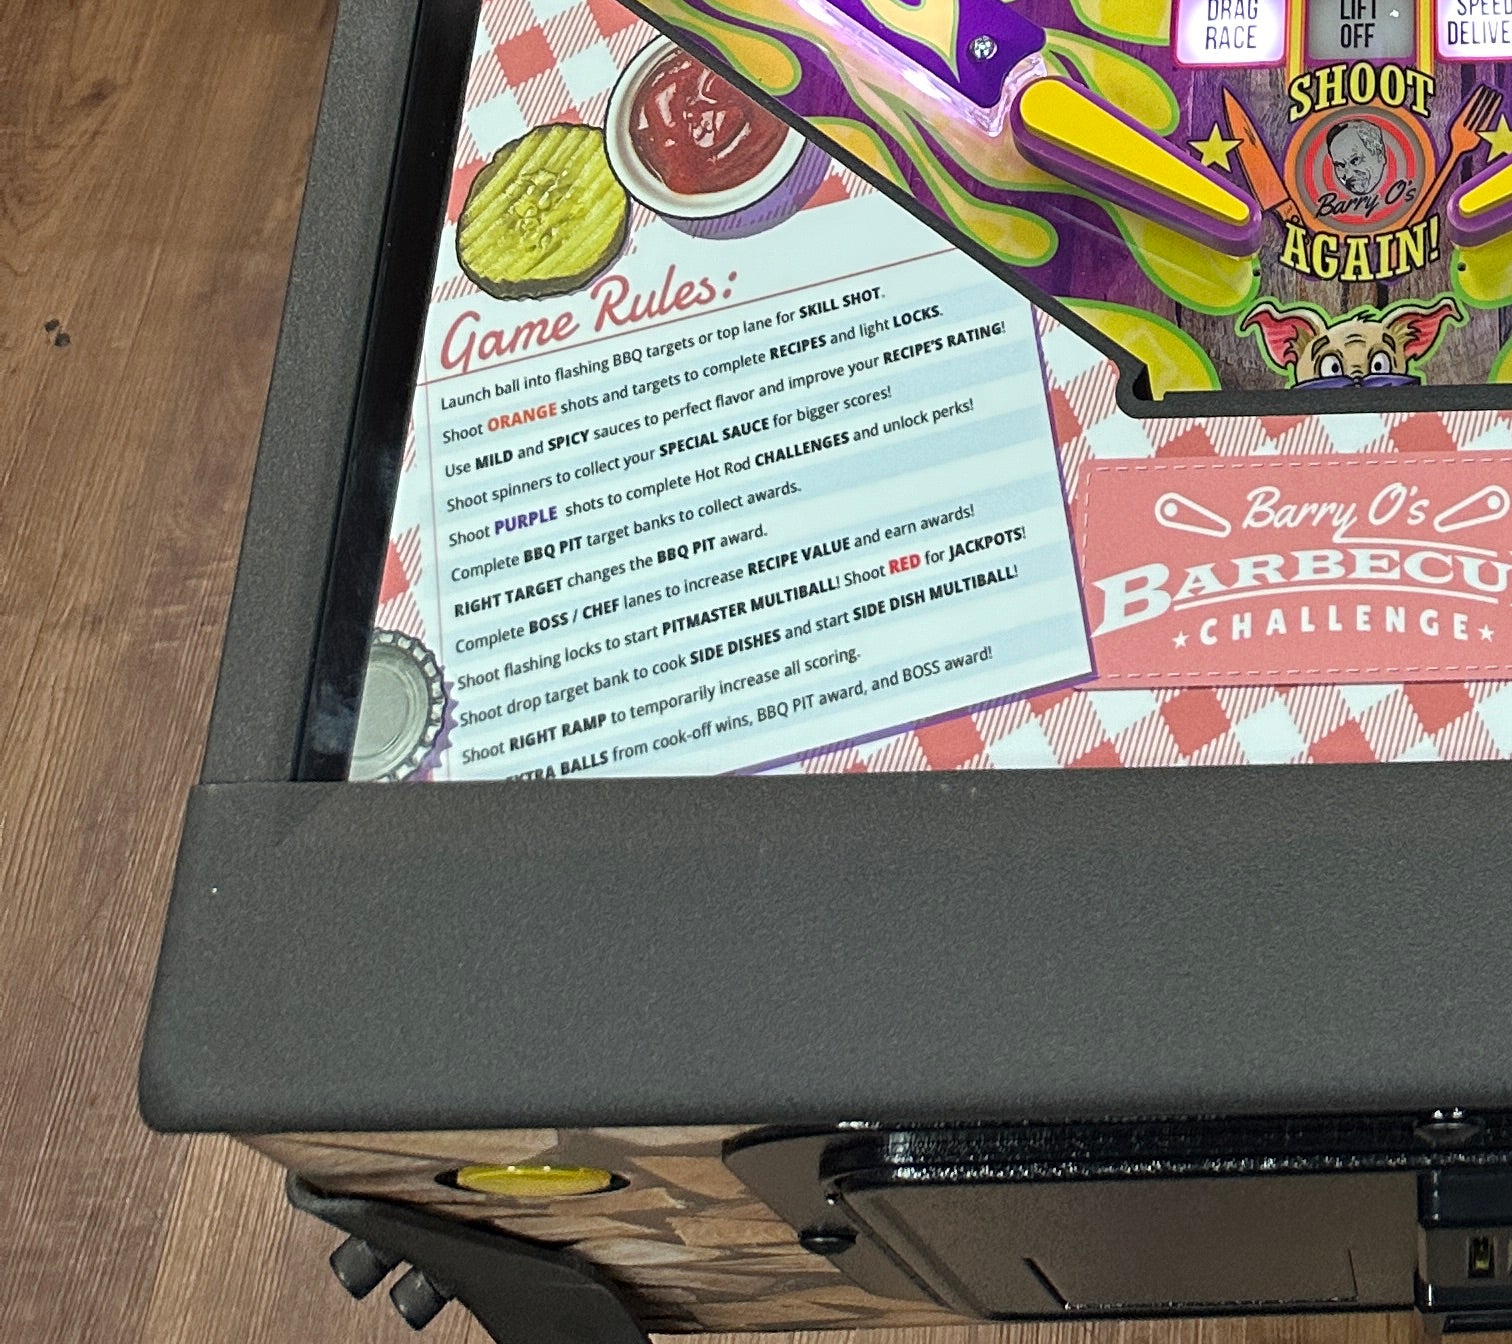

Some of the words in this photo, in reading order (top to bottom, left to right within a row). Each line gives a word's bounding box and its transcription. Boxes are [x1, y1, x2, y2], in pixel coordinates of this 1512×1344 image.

[1203, 24, 1259, 52] RACE
[1339, 20, 1376, 49] OFF
[1289, 61, 1435, 123] SHOOT
[1314, 192, 1379, 219] Barry
[1384, 179, 1417, 205] O's
[1279, 216, 1440, 282] AGAIN!
[438, 306, 582, 373] Game
[590, 264, 739, 335] Rules:
[439, 385, 492, 411] Launch
[493, 376, 521, 397] ball
[522, 373, 552, 390] into
[553, 357, 610, 382] flashing
[611, 347, 643, 368] BBQ
[644, 336, 696, 359] targets
[697, 330, 714, 345] or
[715, 324, 741, 341] top
[741, 316, 773, 334] lane
[774, 309, 796, 326] for
[797, 297, 840, 320] SKILL
[445, 490, 489, 513] Shoot
[490, 474, 553, 503] spinners
[554, 470, 572, 485] to
[573, 456, 621, 480] collect
[621, 447, 656, 472] your
[657, 430, 720, 458] SPECIAL
[720, 415, 770, 442] SAUCE
[771, 412, 794, 429] for
[794, 399, 840, 423] bigger
[841, 383, 892, 410] scores!
[449, 554, 520, 583] Complete
[522, 542, 556, 564] BBQ
[557, 534, 583, 555] PIT
[584, 523, 631, 547] target
[632, 512, 676, 535] banks
[677, 508, 695, 523] to
[696, 493, 744, 518] collect
[745, 479, 802, 505] awards.
[1241, 490, 1363, 543] Barry
[1367, 482, 1430, 528] O's
[453, 591, 502, 618] RIGHT
[502, 575, 564, 605] TARGET
[565, 561, 627, 588] changes
[627, 554, 654, 572] the
[655, 542, 690, 565] BBQ
[691, 535, 716, 556] PIT
[718, 521, 768, 548] award.
[1199, 604, 1471, 646] CHALLENGE
[460, 740, 506, 766] Shoot
[508, 724, 558, 753] RIGHT
[560, 711, 607, 739] RAMP
[609, 709, 627, 725] to
[628, 683, 716, 720] temporarily
[717, 667, 781, 696] increase
[782, 657, 801, 678] all
[803, 646, 861, 672] scoring.
